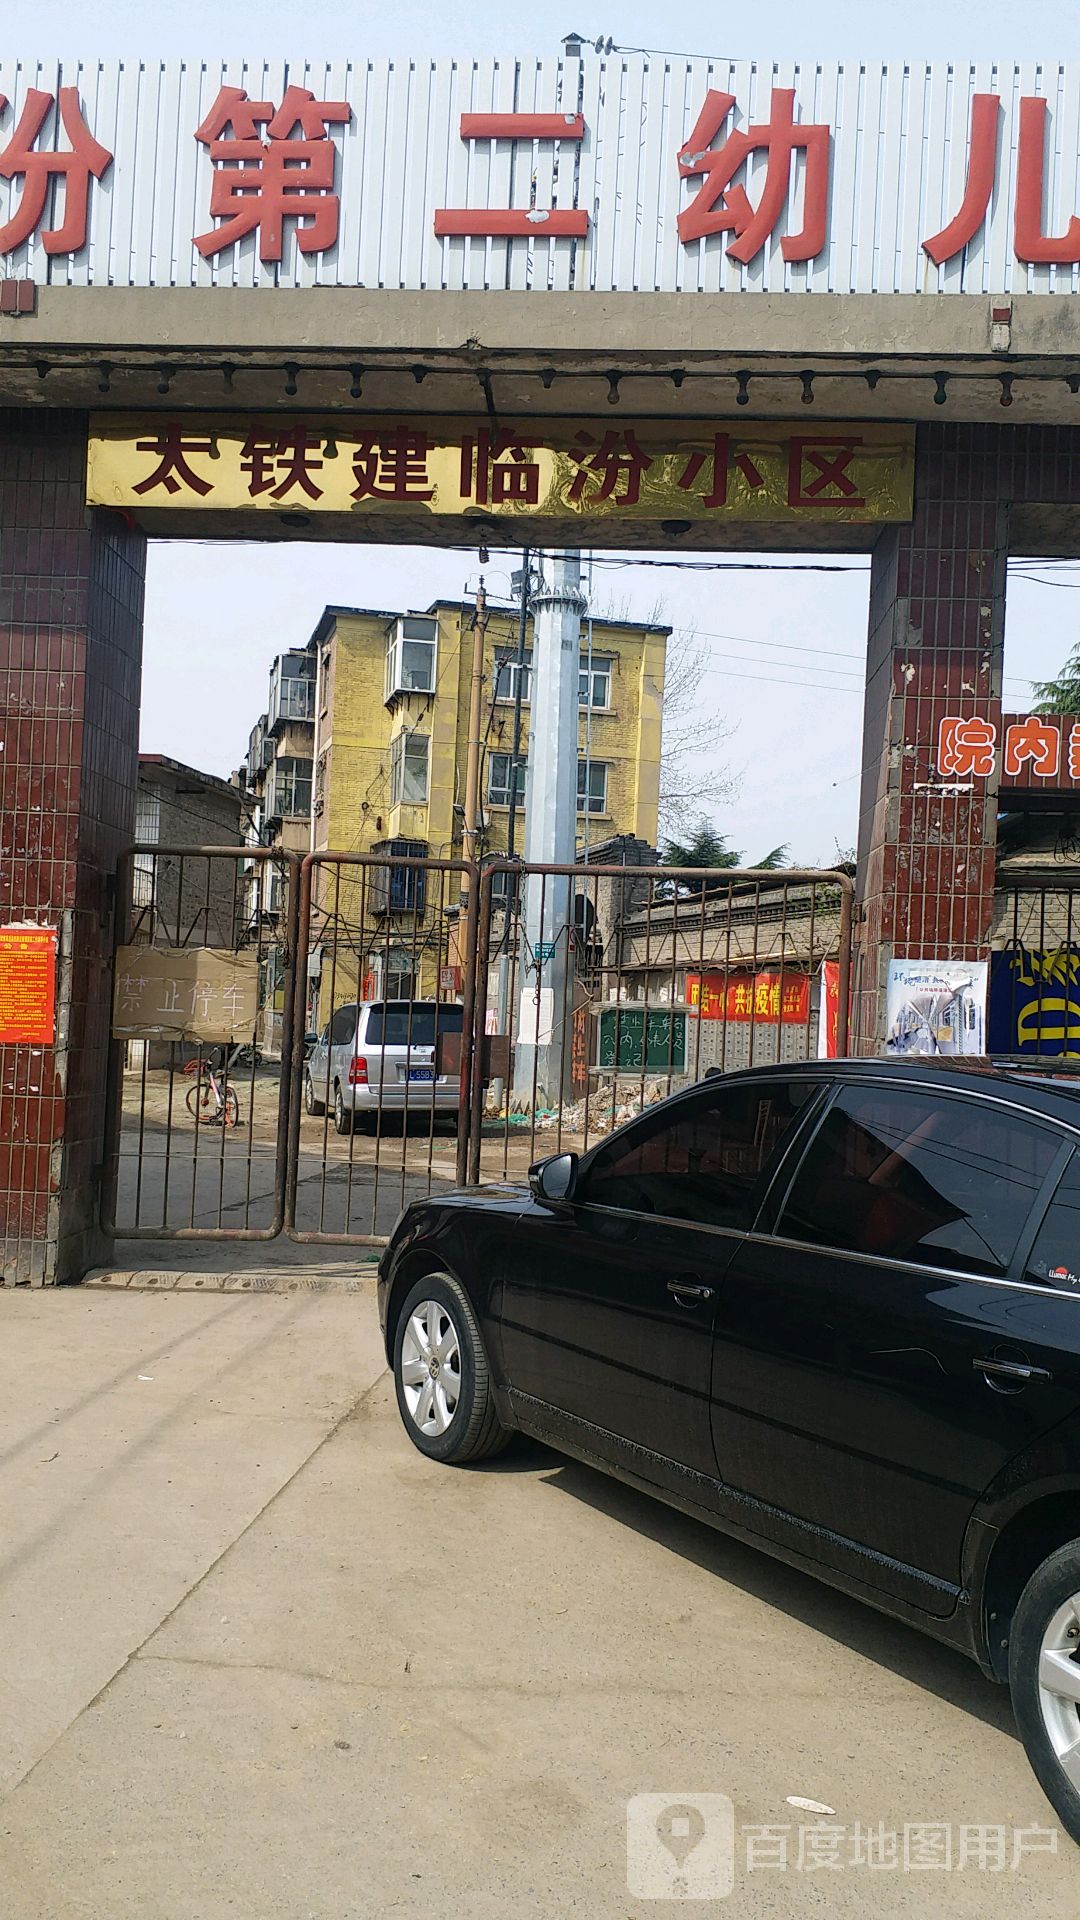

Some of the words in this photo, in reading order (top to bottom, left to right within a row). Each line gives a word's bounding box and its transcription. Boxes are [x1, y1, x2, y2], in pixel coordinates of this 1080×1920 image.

[132, 423, 866, 510] 太铁建临汾小区
[937, 716, 1080, 779] 院内
[120, 973, 245, 1016] 禁止停车
